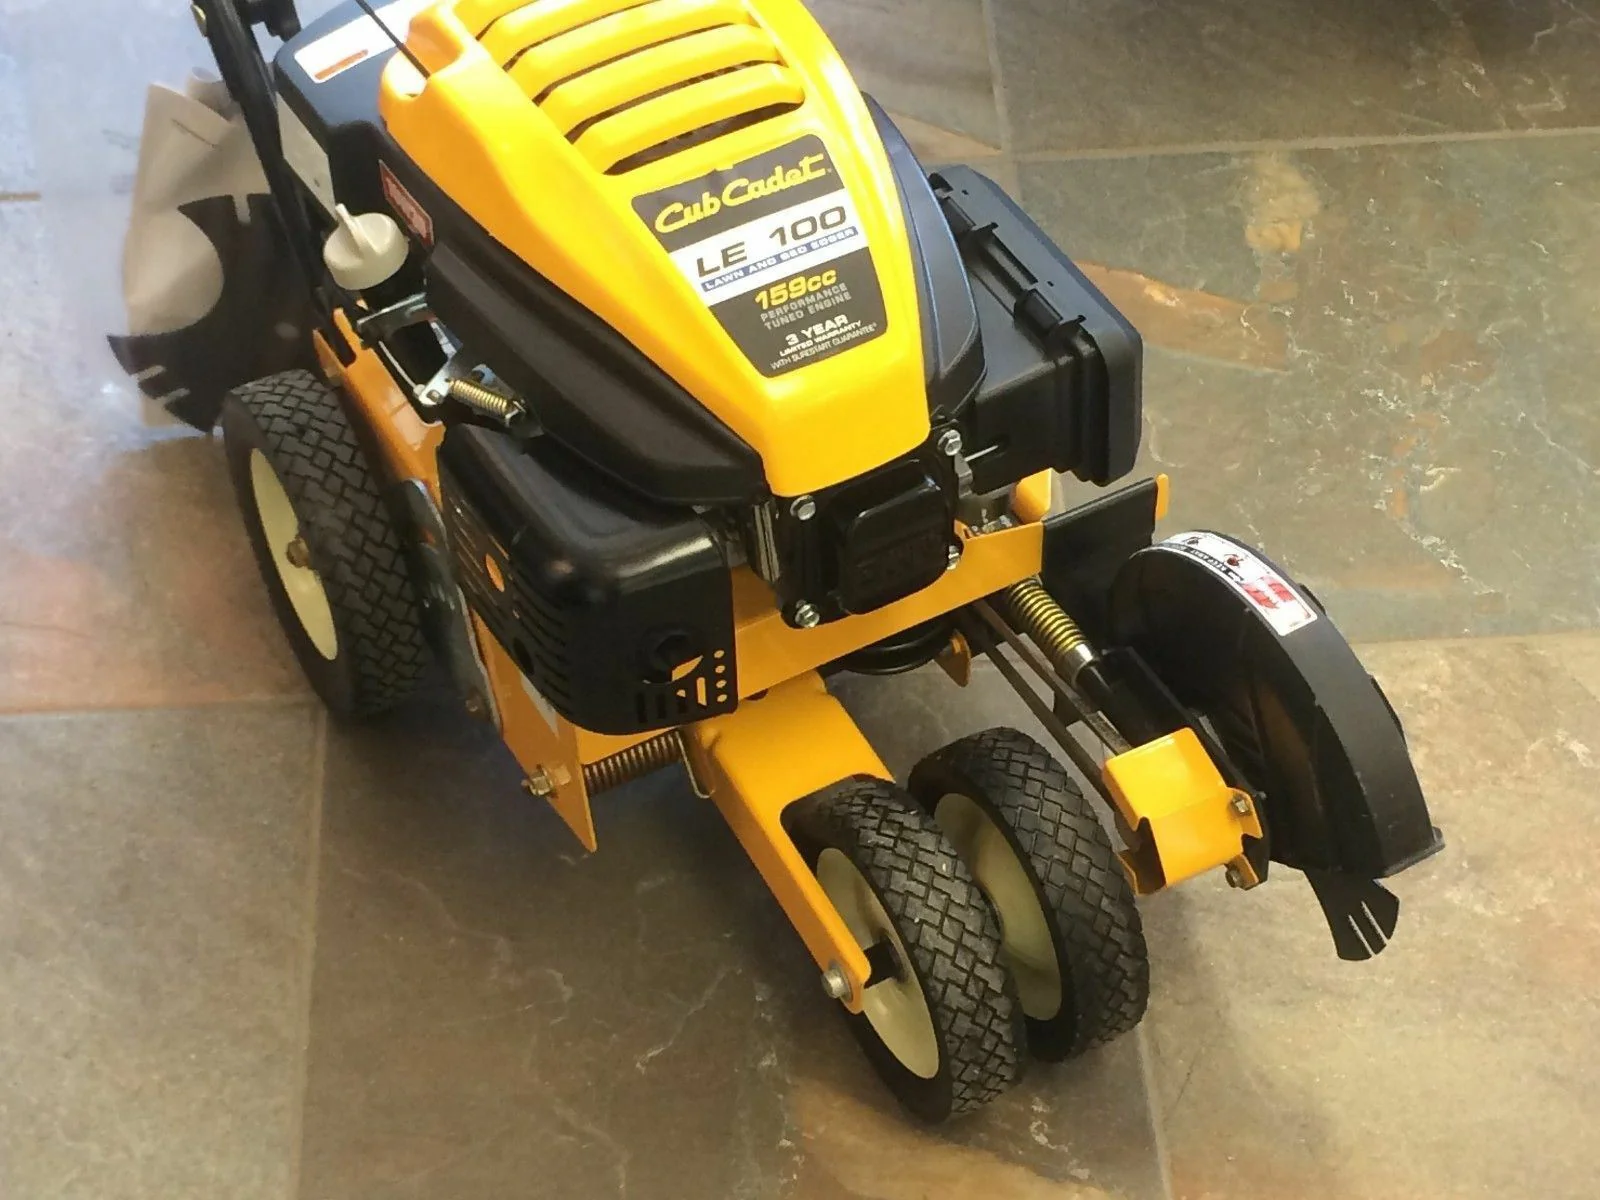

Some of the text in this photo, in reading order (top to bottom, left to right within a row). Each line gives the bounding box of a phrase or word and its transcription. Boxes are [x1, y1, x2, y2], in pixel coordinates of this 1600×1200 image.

[655, 153, 826, 233] Cub Cadet
[697, 206, 846, 277] LE 100
[704, 269, 744, 290] LAWN
[749, 257, 777, 274] AND
[755, 269, 837, 310] 159cc
[760, 282, 848, 321] PERFORMANCE
[764, 291, 852, 330] TUNED ENGINE
[780, 320, 861, 357] LIMITED WARRANTY
[785, 314, 849, 346] 3 YEAR
